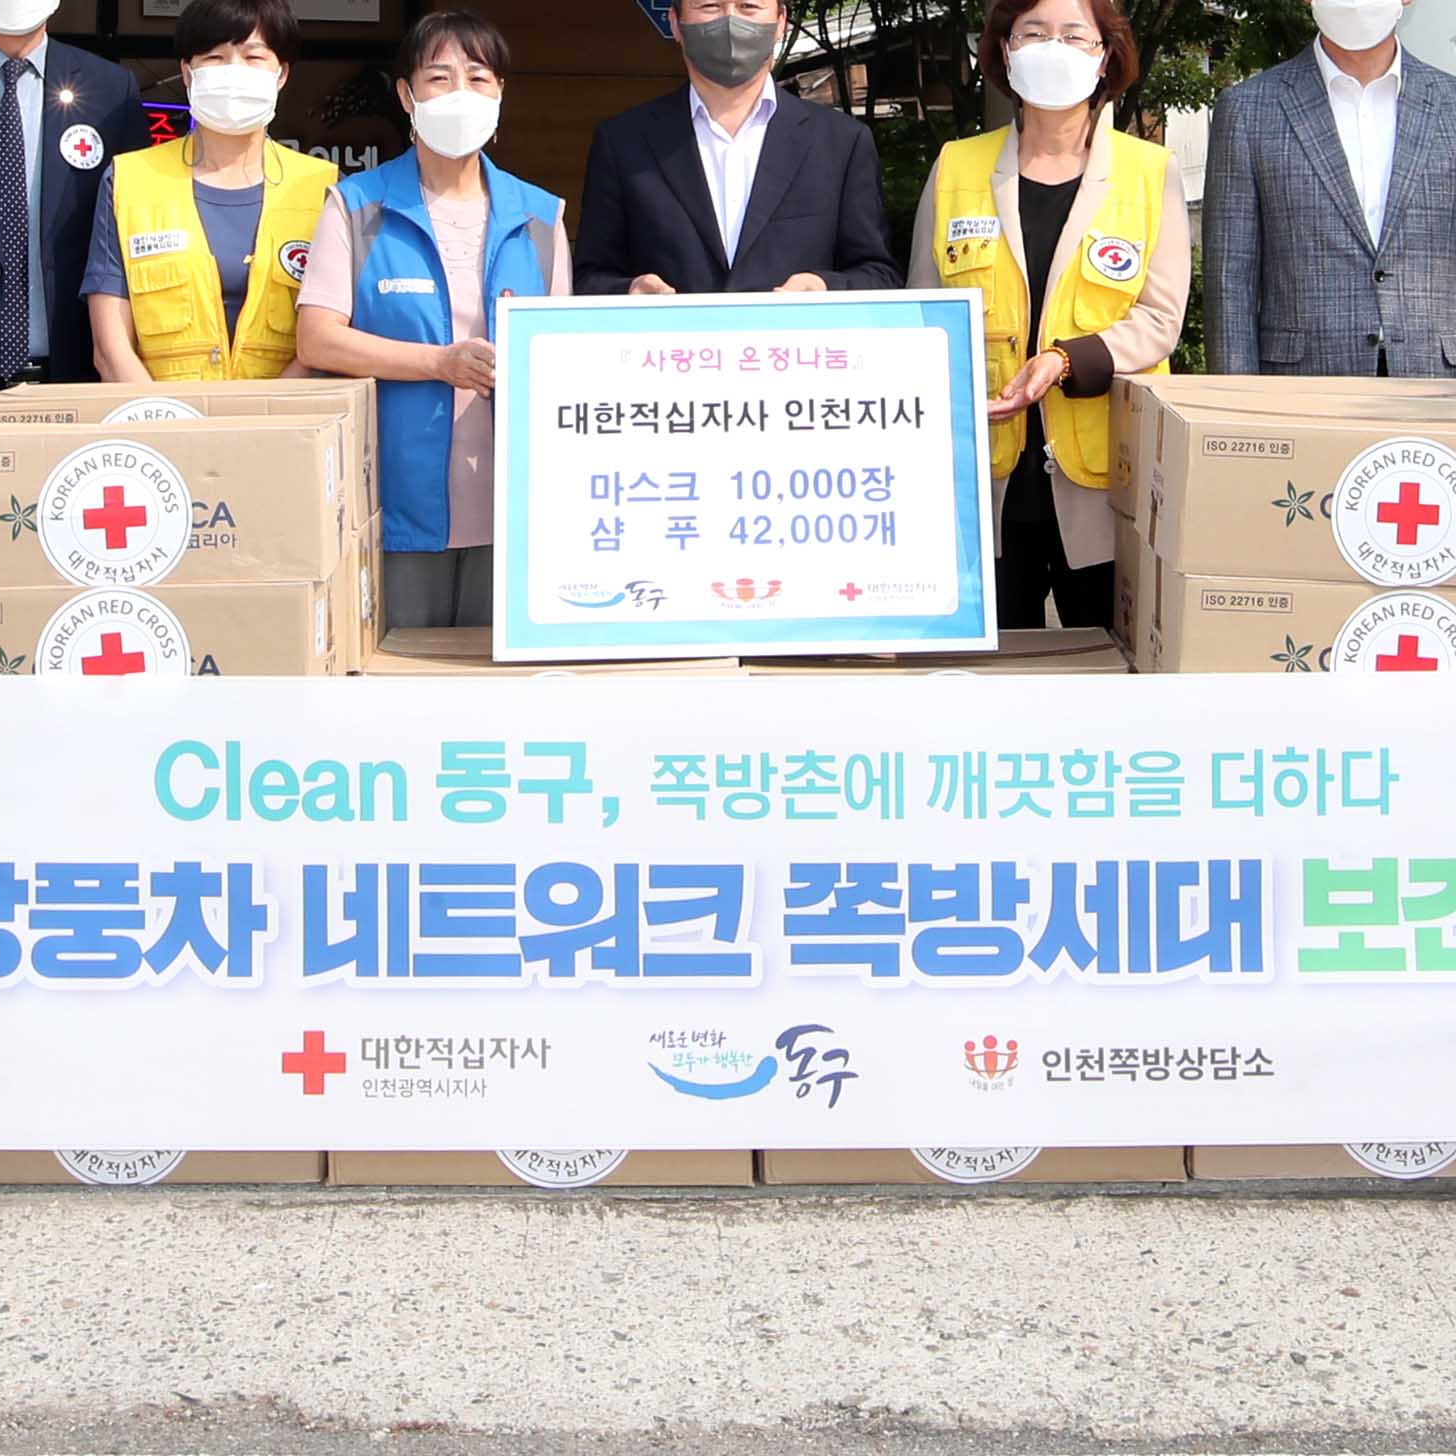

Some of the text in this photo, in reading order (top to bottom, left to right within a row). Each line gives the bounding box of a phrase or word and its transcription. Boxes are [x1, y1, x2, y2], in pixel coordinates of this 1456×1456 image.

[556, 396, 925, 435] 대한적십자사 인천지사
[1206, 440, 1290, 456] ISO 22716 인증
[49, 452, 180, 522] KOREAN RED CROSS
[589, 466, 895, 506] 마스크 10,000장
[1345, 452, 1396, 512] KOREAN
[1401, 449, 1436, 468] RED
[590, 510, 896, 552] 샴 푸 42,000개
[67, 546, 170, 584] 대한적십자사
[1355, 541, 1456, 579] 대한적십자사
[1205, 594, 1289, 610] ISO 22716 인증
[49, 599, 178, 670] KOREAN RED CROSS
[1343, 603, 1396, 664] KOREAN
[1400, 601, 1435, 621] RED
[154, 739, 1400, 828] Clean 동구, 쪽방촌에 깨끗함을 더하다
[302, 860, 749, 979] 네트워크
[780, 860, 1265, 978] 쪽방세대
[360, 1034, 552, 1070] 대한적십자사
[649, 1029, 727, 1049] 새로운 변화
[671, 1050, 754, 1073] 모두가 행복한
[775, 1023, 860, 1109] 동구
[1041, 1046, 1276, 1082] 인천쪽방상담소
[361, 1077, 488, 1099] 인천광역시지사
